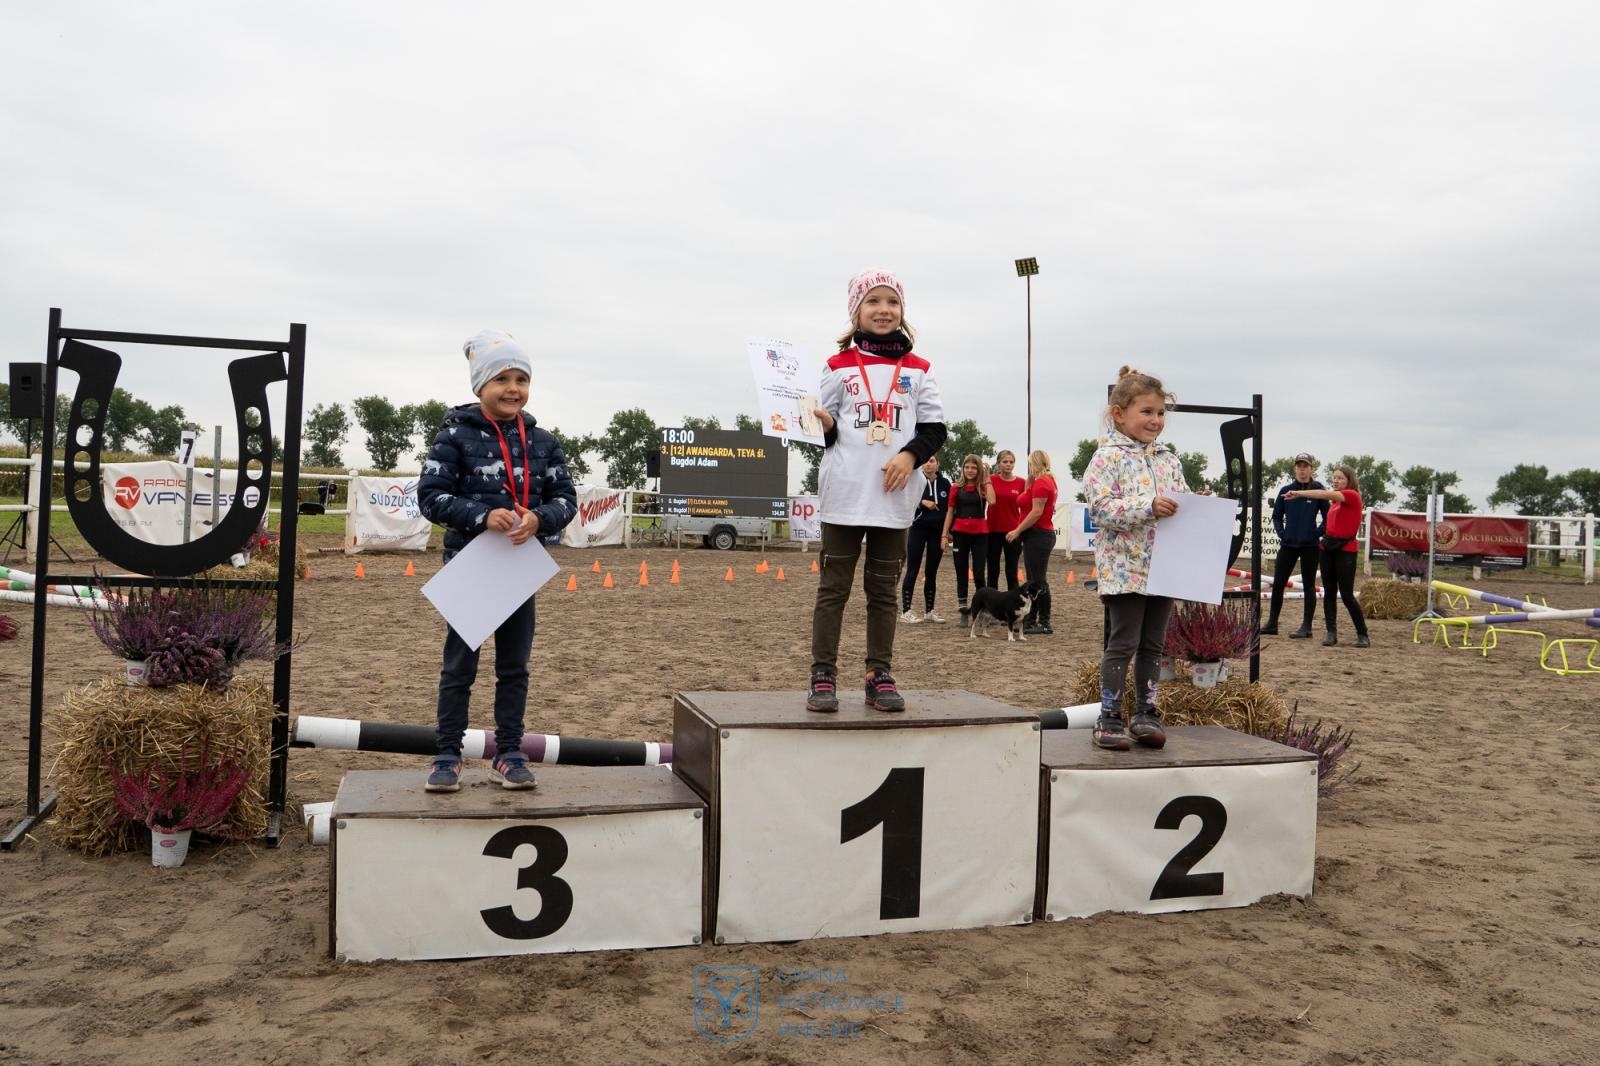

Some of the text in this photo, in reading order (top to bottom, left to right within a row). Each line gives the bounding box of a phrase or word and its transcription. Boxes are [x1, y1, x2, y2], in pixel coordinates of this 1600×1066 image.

[846, 382, 859, 396] 43
[662, 429, 694, 443] 18:00
[182, 438, 194, 464] 7
[661, 445, 669, 455] 3.
[670, 445, 684, 456] [12]
[686, 446, 735, 458] AWANGARDA,
[737, 448, 755, 457] TEYA
[671, 457, 718, 467] Bugdol Adam
[792, 500, 815, 520] bp
[840, 767, 925, 921] 1
[1149, 795, 1229, 900] 2
[480, 824, 573, 940] 3
